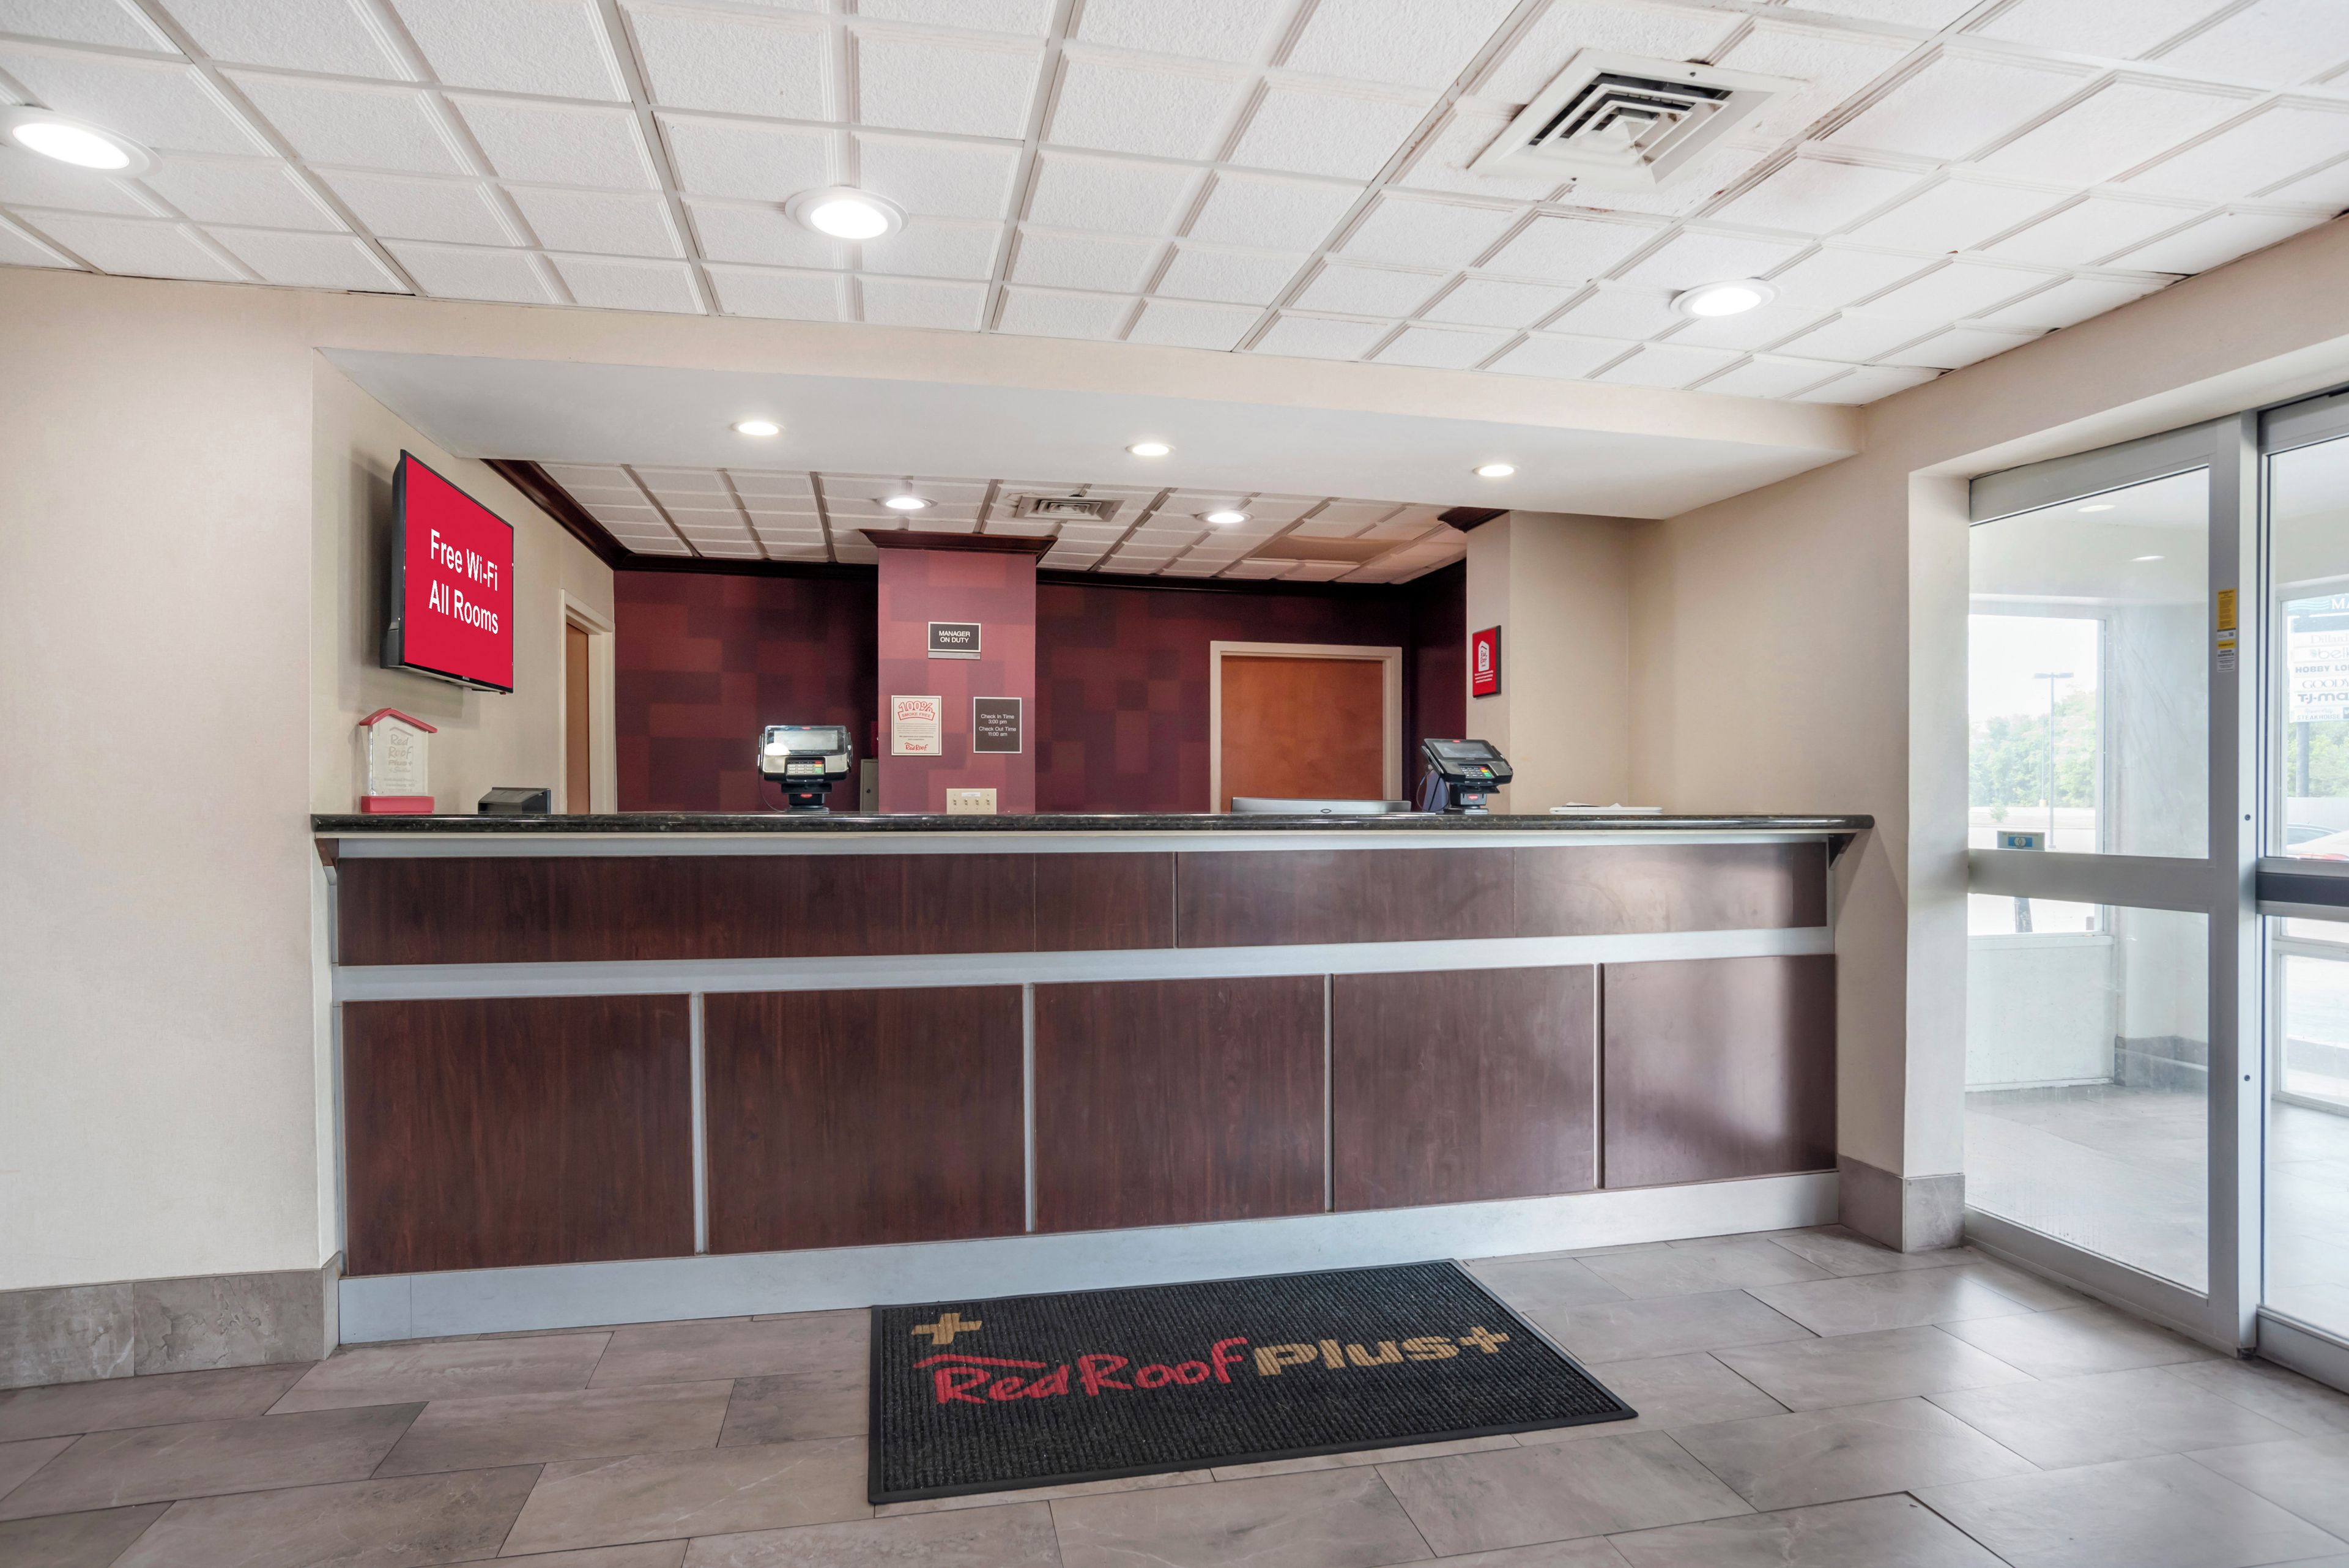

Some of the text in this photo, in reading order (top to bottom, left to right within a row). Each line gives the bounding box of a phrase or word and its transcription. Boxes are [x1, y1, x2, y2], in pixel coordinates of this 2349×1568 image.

[431, 529, 497, 592] Free Wi-Fi
[429, 579, 499, 634] All Rooms
[898, 700, 933, 712] 100%
[388, 746, 413, 759] Roof
[390, 734, 409, 746] Red
[933, 1363, 1071, 1405] Red
[1078, 1336, 1249, 1397] Roof
